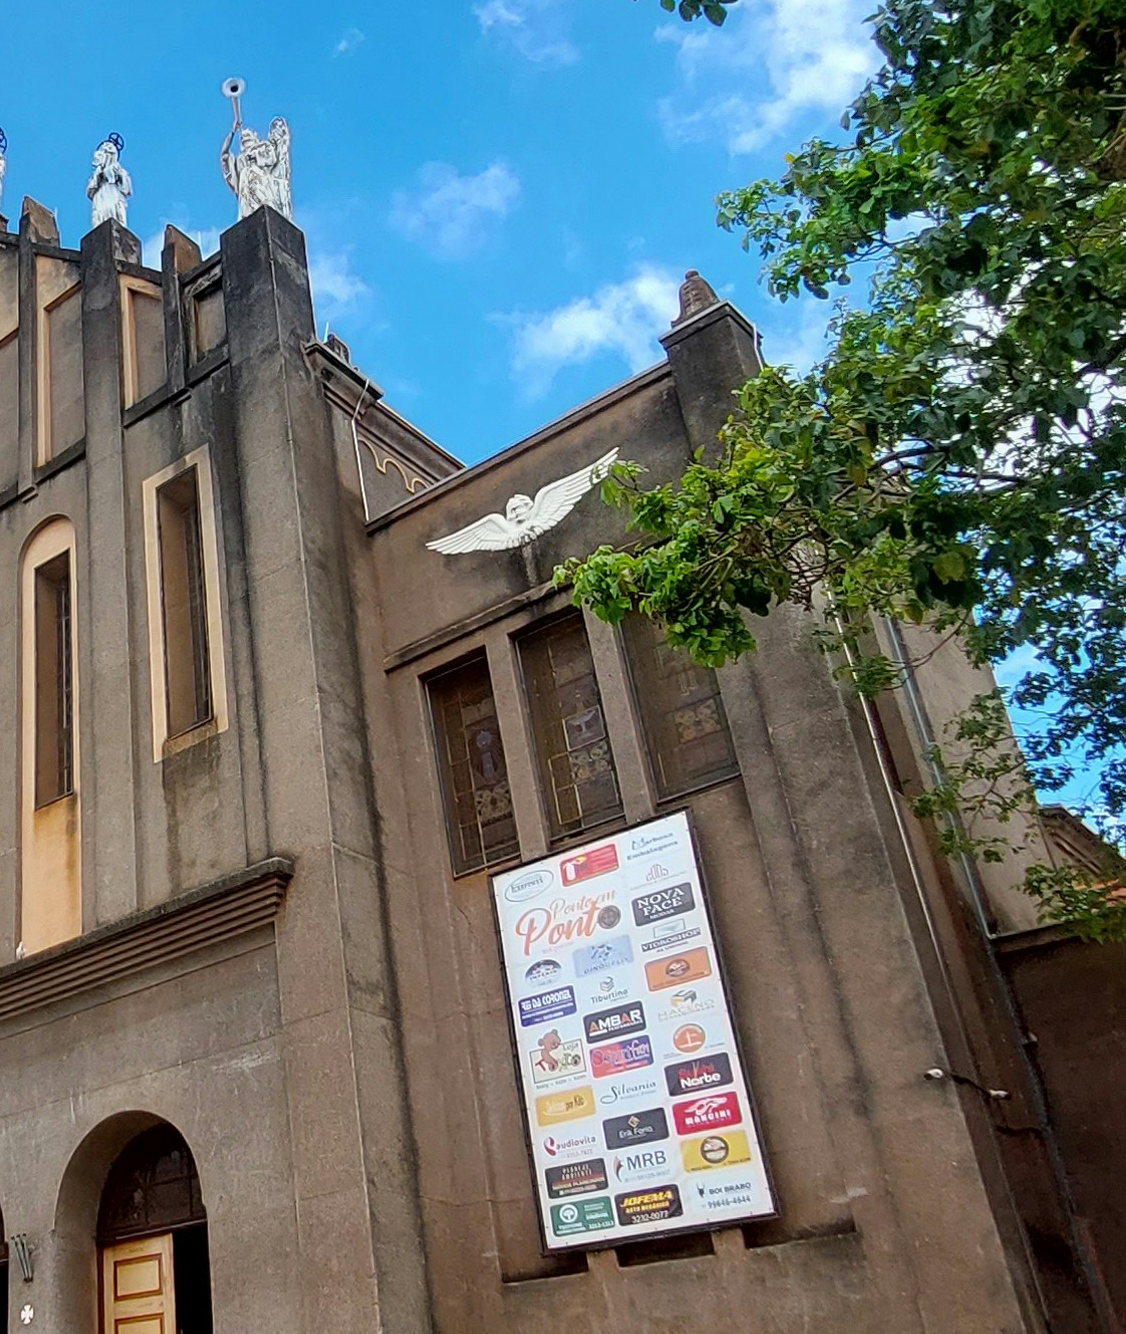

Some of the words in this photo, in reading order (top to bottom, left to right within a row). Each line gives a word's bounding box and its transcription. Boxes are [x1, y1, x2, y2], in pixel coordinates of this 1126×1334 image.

[637, 887, 684, 909] NOVA
[643, 897, 683, 917] FACE
[589, 1008, 642, 1033] AMBAR
[600, 1080, 657, 1105] Silvania
[684, 1109, 731, 1126] MANCINI
[556, 1135, 596, 1151] audiovita
[627, 1150, 667, 1171] MRB
[620, 1189, 673, 1208] JOFEMA
[709, 1186, 722, 1195] BOI
[724, 1182, 752, 1193] BRABO
